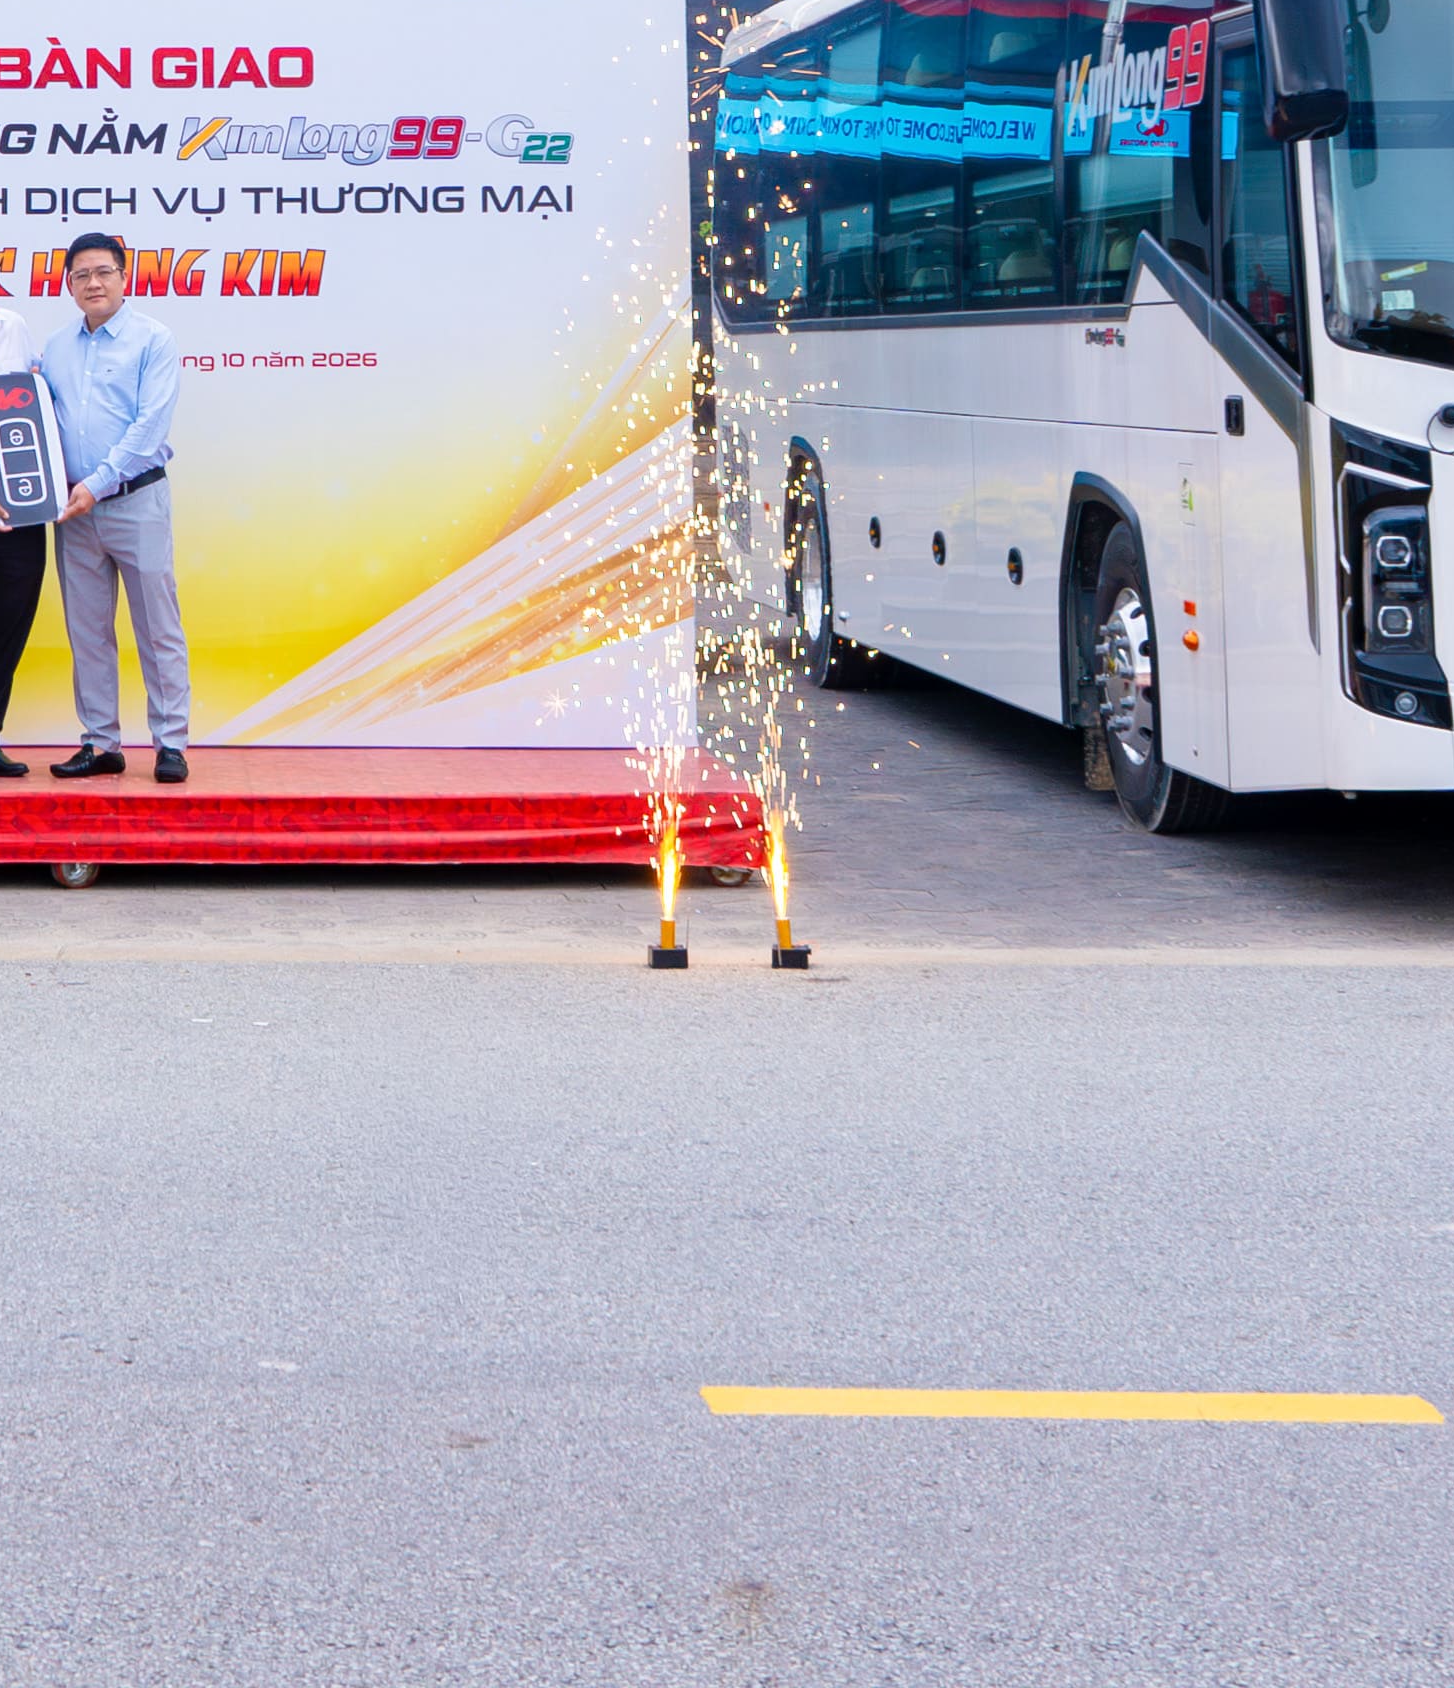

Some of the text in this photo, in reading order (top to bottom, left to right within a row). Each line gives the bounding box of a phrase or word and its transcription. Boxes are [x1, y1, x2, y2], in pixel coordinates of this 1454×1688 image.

[151, 46, 314, 89] GIAO
[1068, 18, 1210, 137] KimLong99
[47, 107, 168, 155] NẰM
[25, 187, 137, 223] DỊCH
[152, 187, 226, 223] VỤ
[241, 182, 465, 215] THƯƠNG
[481, 184, 574, 221] MẠI
[29, 235, 211, 297] HNG
[220, 249, 326, 297] KIM
[221, 353, 245, 368] 10
[252, 351, 305, 368] năm
[311, 352, 378, 368] 2026
